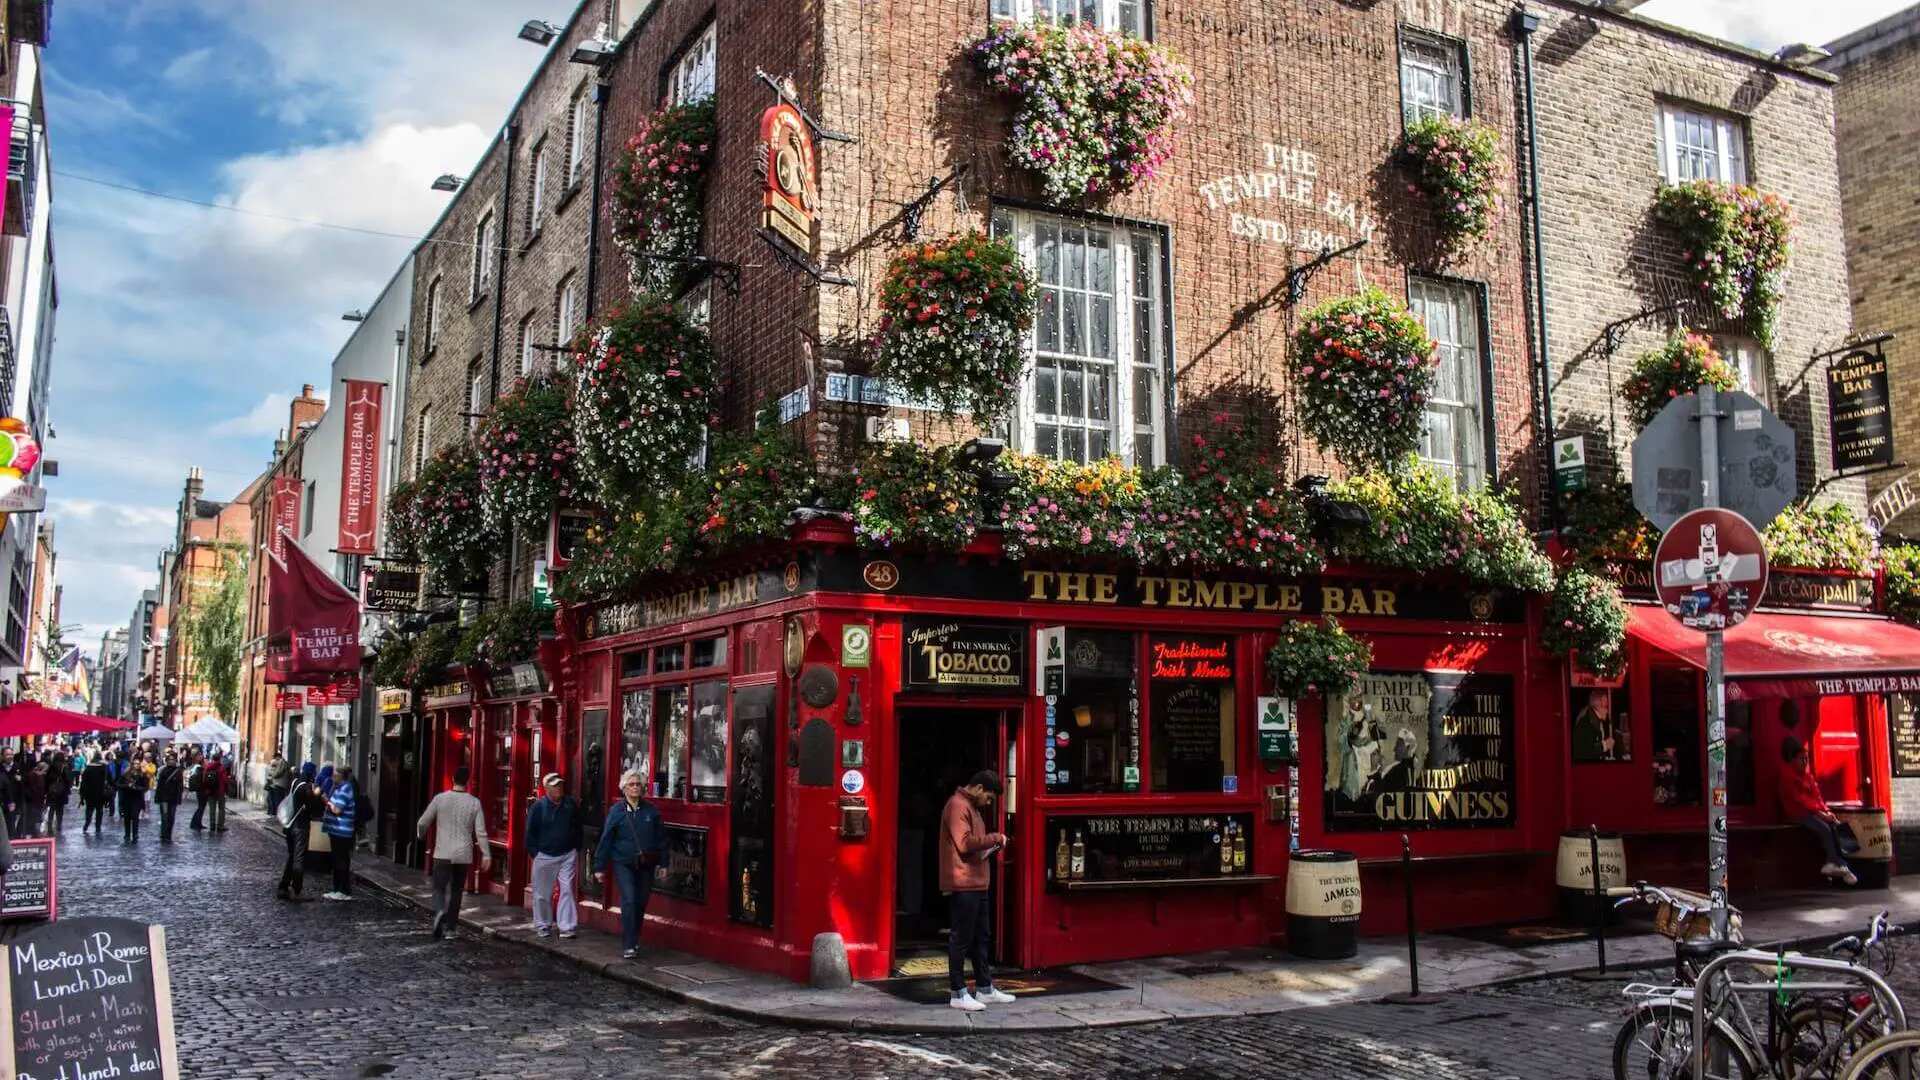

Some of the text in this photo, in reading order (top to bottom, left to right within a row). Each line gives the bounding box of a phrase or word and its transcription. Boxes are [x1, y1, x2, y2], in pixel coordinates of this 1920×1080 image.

[1262, 142, 1318, 176] THE
[1200, 173, 1379, 242] TEMPLE BAR
[1847, 356, 1865, 367] THE
[1829, 361, 1885, 383] TEMPLE
[1843, 378, 1872, 395] BAR
[1834, 404, 1886, 422] BEER GARDEN
[1838, 436, 1886, 452] LIVE MUSIC
[1848, 447, 1875, 459] DAILY
[348, 412, 364, 525] THE TEMPLE BAR
[362, 452, 374, 506] TRADING
[1873, 477, 1917, 525] THE
[871, 566, 891, 583] 48
[644, 587, 711, 627] TEMPLE
[717, 572, 759, 609] BAR
[1024, 570, 1119, 602] THE
[1136, 576, 1302, 612] TEMPLE
[1322, 586, 1397, 615] BAR
[296, 634, 354, 648] TEMPLE
[312, 627, 337, 637] THE
[907, 623, 959, 645] Importers
[939, 635, 948, 643] OF
[311, 647, 341, 659] BAR
[953, 641, 1011, 652] FINE SMOKING
[1153, 641, 1228, 659] Traditional
[921, 645, 1012, 680] TOBACCO
[1152, 660, 1232, 678] Irish Music
[1361, 680, 1426, 697] TEMPLE
[1816, 677, 1920, 694] THE TEMPLE BA
[1381, 697, 1413, 714] BAR
[1475, 694, 1500, 714] THE
[1442, 715, 1501, 736] EMPEROR
[1486, 739, 1502, 757] OF
[1407, 767, 1457, 790] MALTED
[1375, 791, 1509, 821] GUINNESS
[1580, 864, 1621, 877] JAESON
[5, 891, 45, 901] DONUTS
[15, 942, 84, 975] Mexico
[91, 931, 149, 964] Rome
[34, 962, 133, 1000] Lunch Deal
[19, 1004, 83, 1034] Starter
[47, 1034, 82, 1052] glass
[89, 1026, 105, 1042] of
[113, 1023, 143, 1036] wine
[35, 1040, 138, 1064] or soft drink
[129, 1048, 161, 1073] deal
